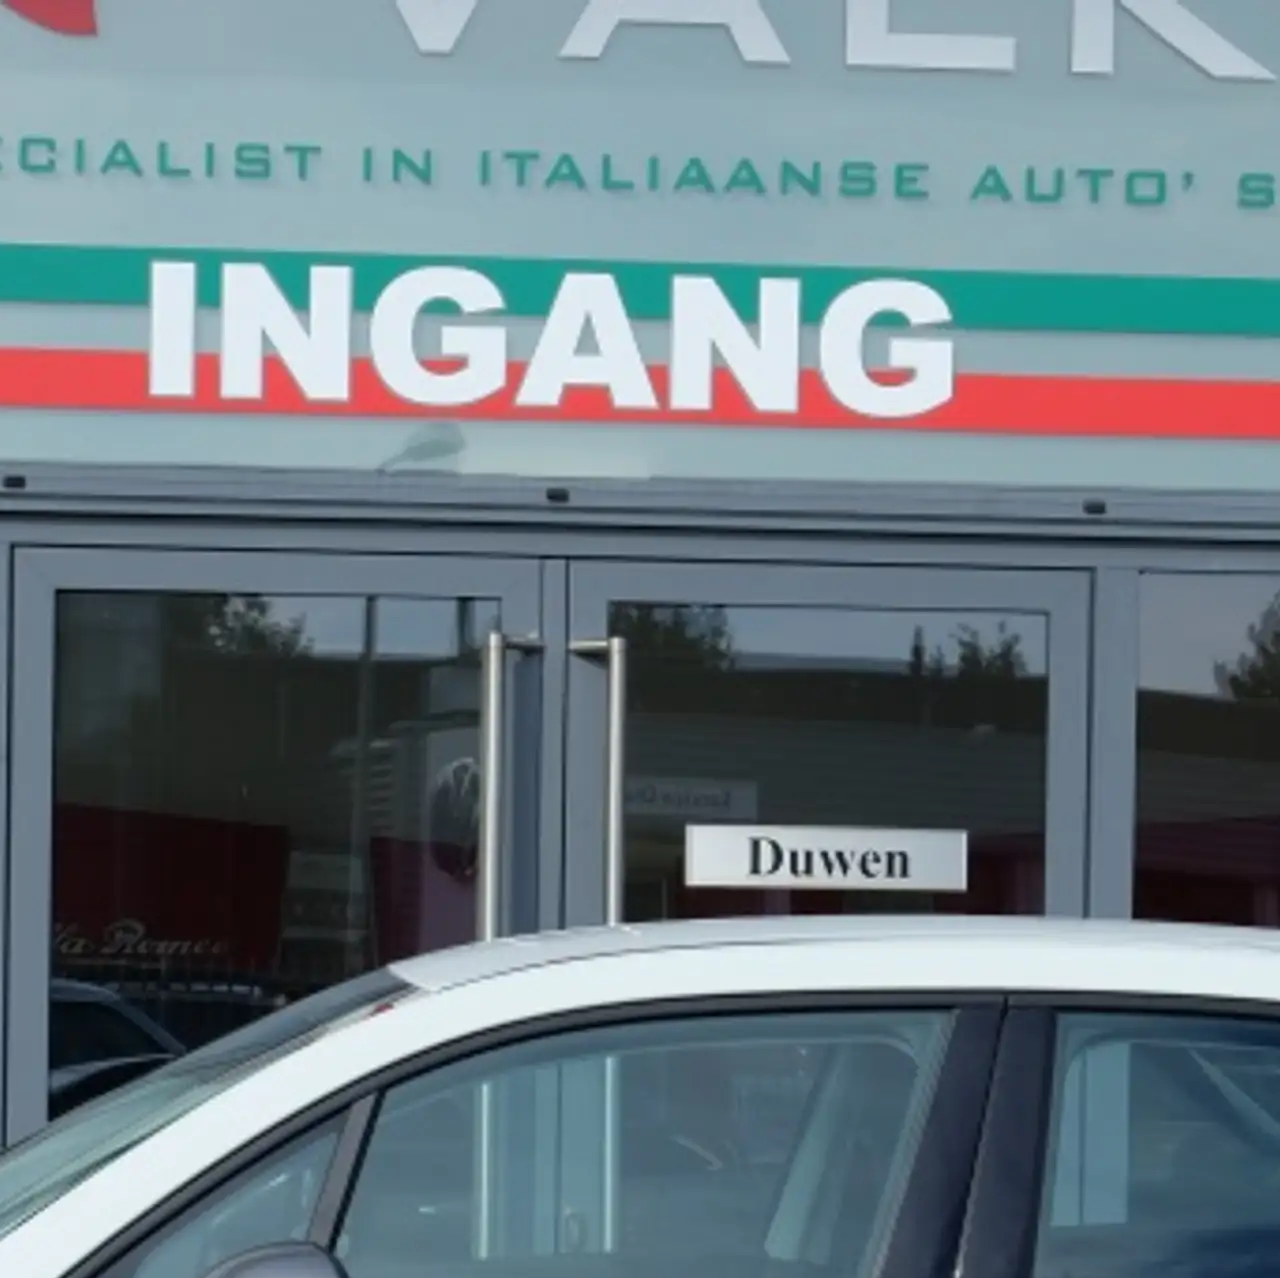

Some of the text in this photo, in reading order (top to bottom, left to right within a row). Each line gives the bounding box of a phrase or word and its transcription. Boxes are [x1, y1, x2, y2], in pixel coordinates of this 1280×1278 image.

[361, 148, 432, 186] IN
[479, 150, 930, 198] ITALIAANSE
[147, 260, 955, 419] INGANG
[747, 836, 911, 878] Duwen
